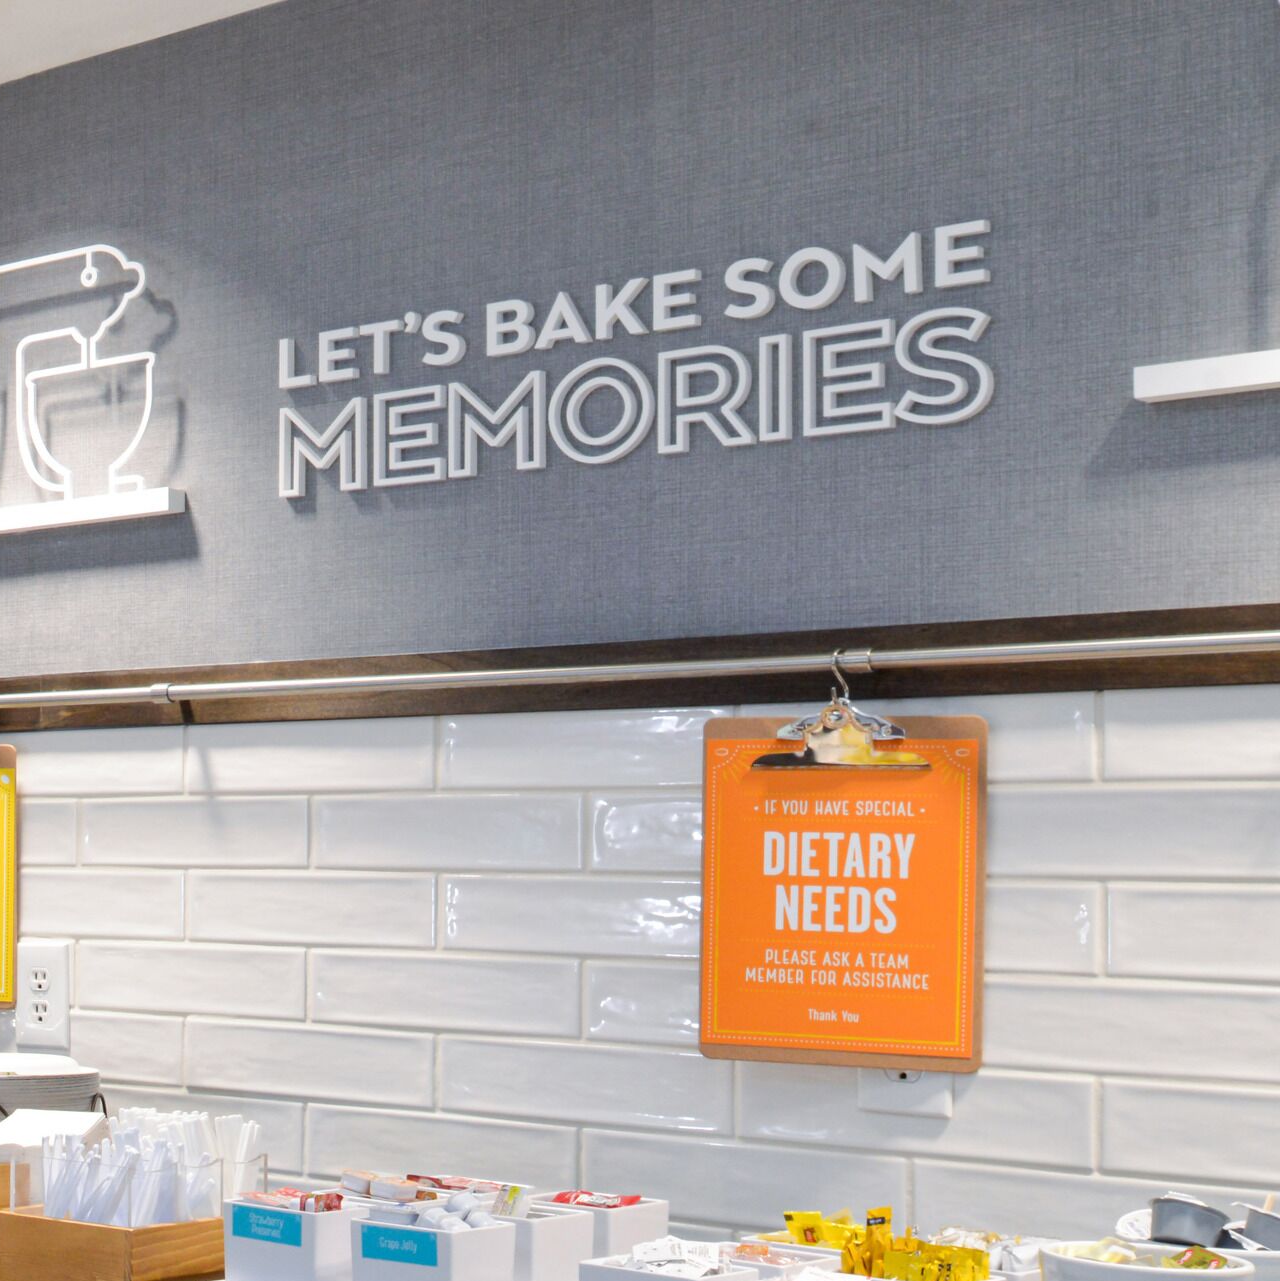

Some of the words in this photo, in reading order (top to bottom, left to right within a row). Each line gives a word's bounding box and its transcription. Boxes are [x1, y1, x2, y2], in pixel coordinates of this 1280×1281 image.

[278, 308, 466, 390] LET'S
[485, 267, 703, 359] BAKE
[724, 219, 992, 319] SOME
[278, 305, 996, 500] MEMORIES
[765, 799, 778, 815] IF
[782, 799, 809, 815] YOU
[815, 800, 850, 816] HAVE
[855, 800, 915, 817] SPECIAL
[762, 830, 916, 880] DIETARY
[774, 884, 897, 934] NEEDS
[765, 948, 817, 966] PLEASE
[822, 951, 850, 967] ASK
[855, 952, 865, 968] A
[870, 953, 910, 969] TEAM
[745, 967, 804, 984] MEMBER
[811, 969, 837, 985] FOR
[842, 971, 929, 990] ASSISTANCE
[808, 1008, 838, 1022] Thank
[841, 1010, 860, 1023] You
